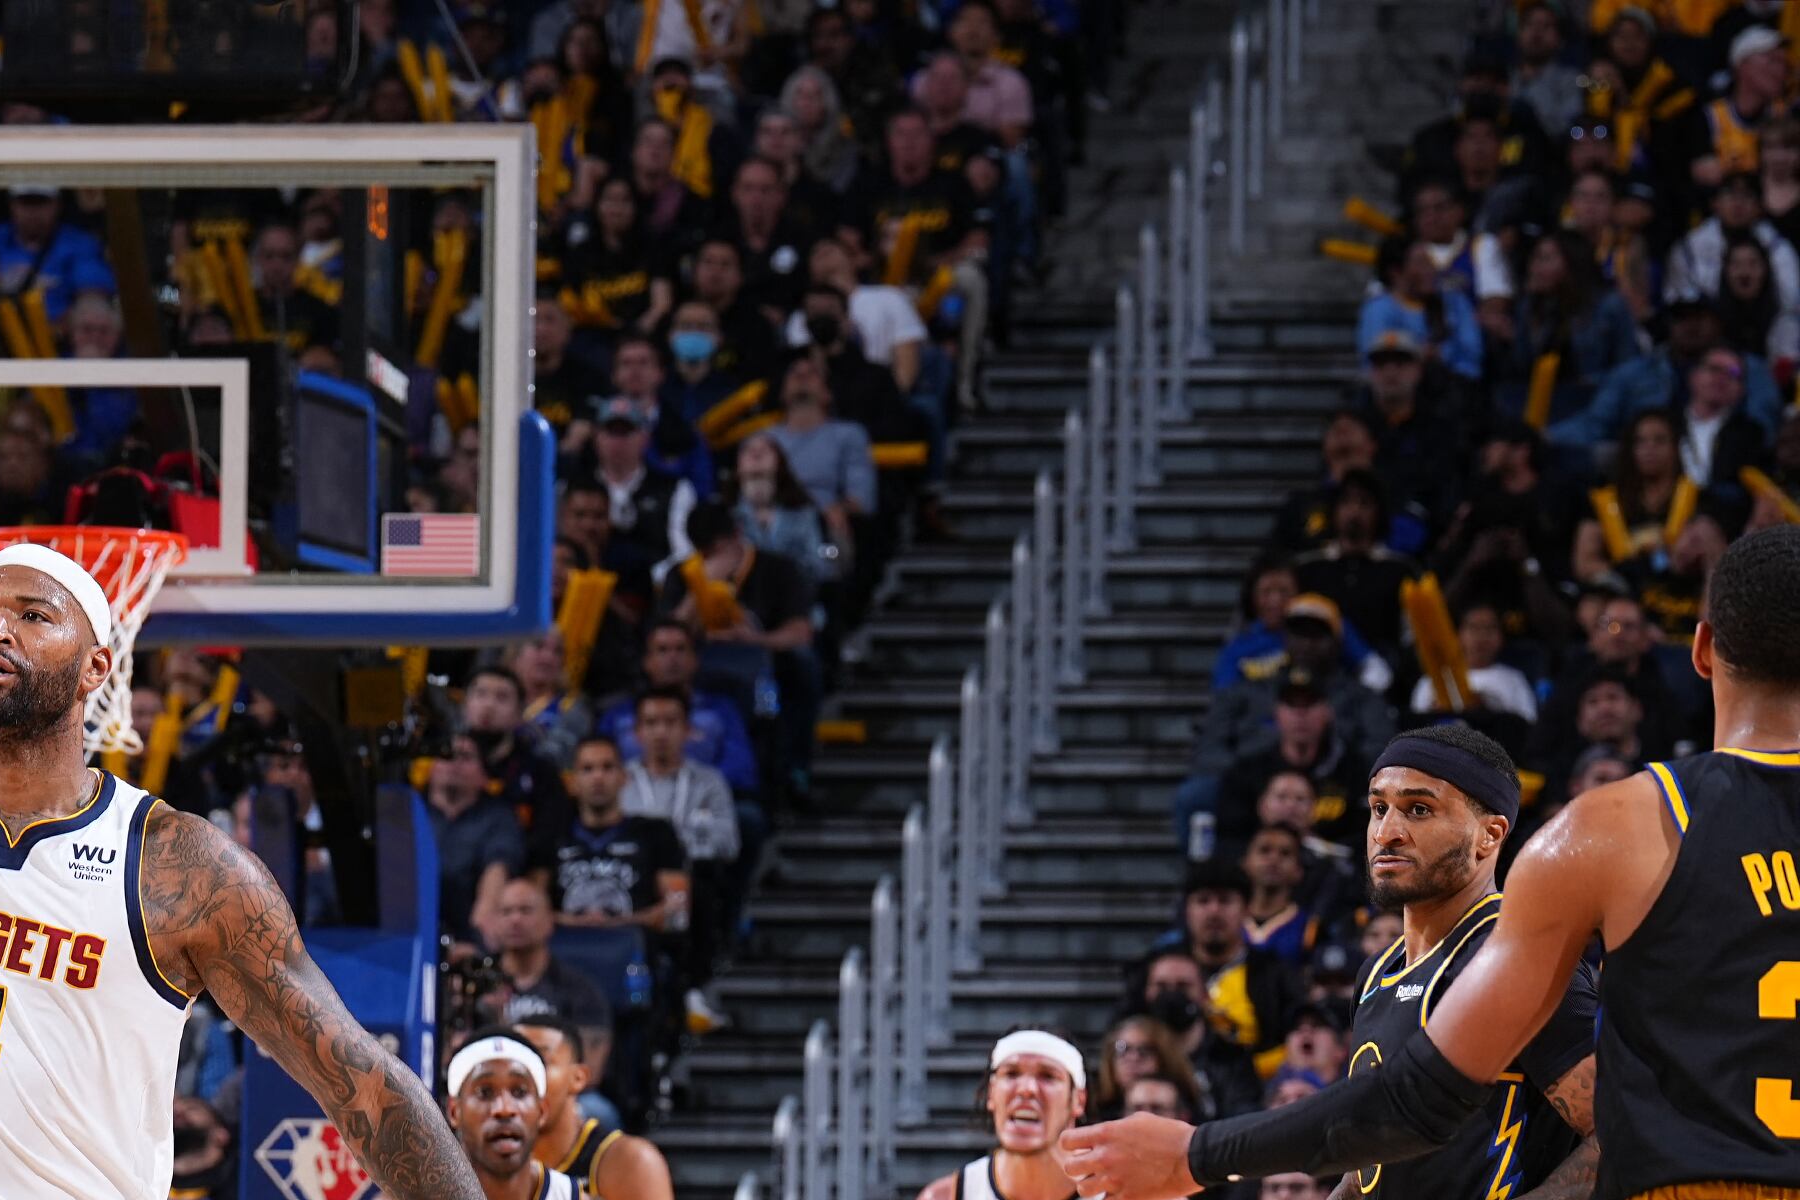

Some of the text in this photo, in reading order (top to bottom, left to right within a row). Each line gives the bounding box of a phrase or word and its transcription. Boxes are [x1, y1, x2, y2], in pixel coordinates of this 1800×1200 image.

[73, 843, 116, 864] WU
[69, 861, 112, 875] Western
[74, 871, 104, 882] Union
